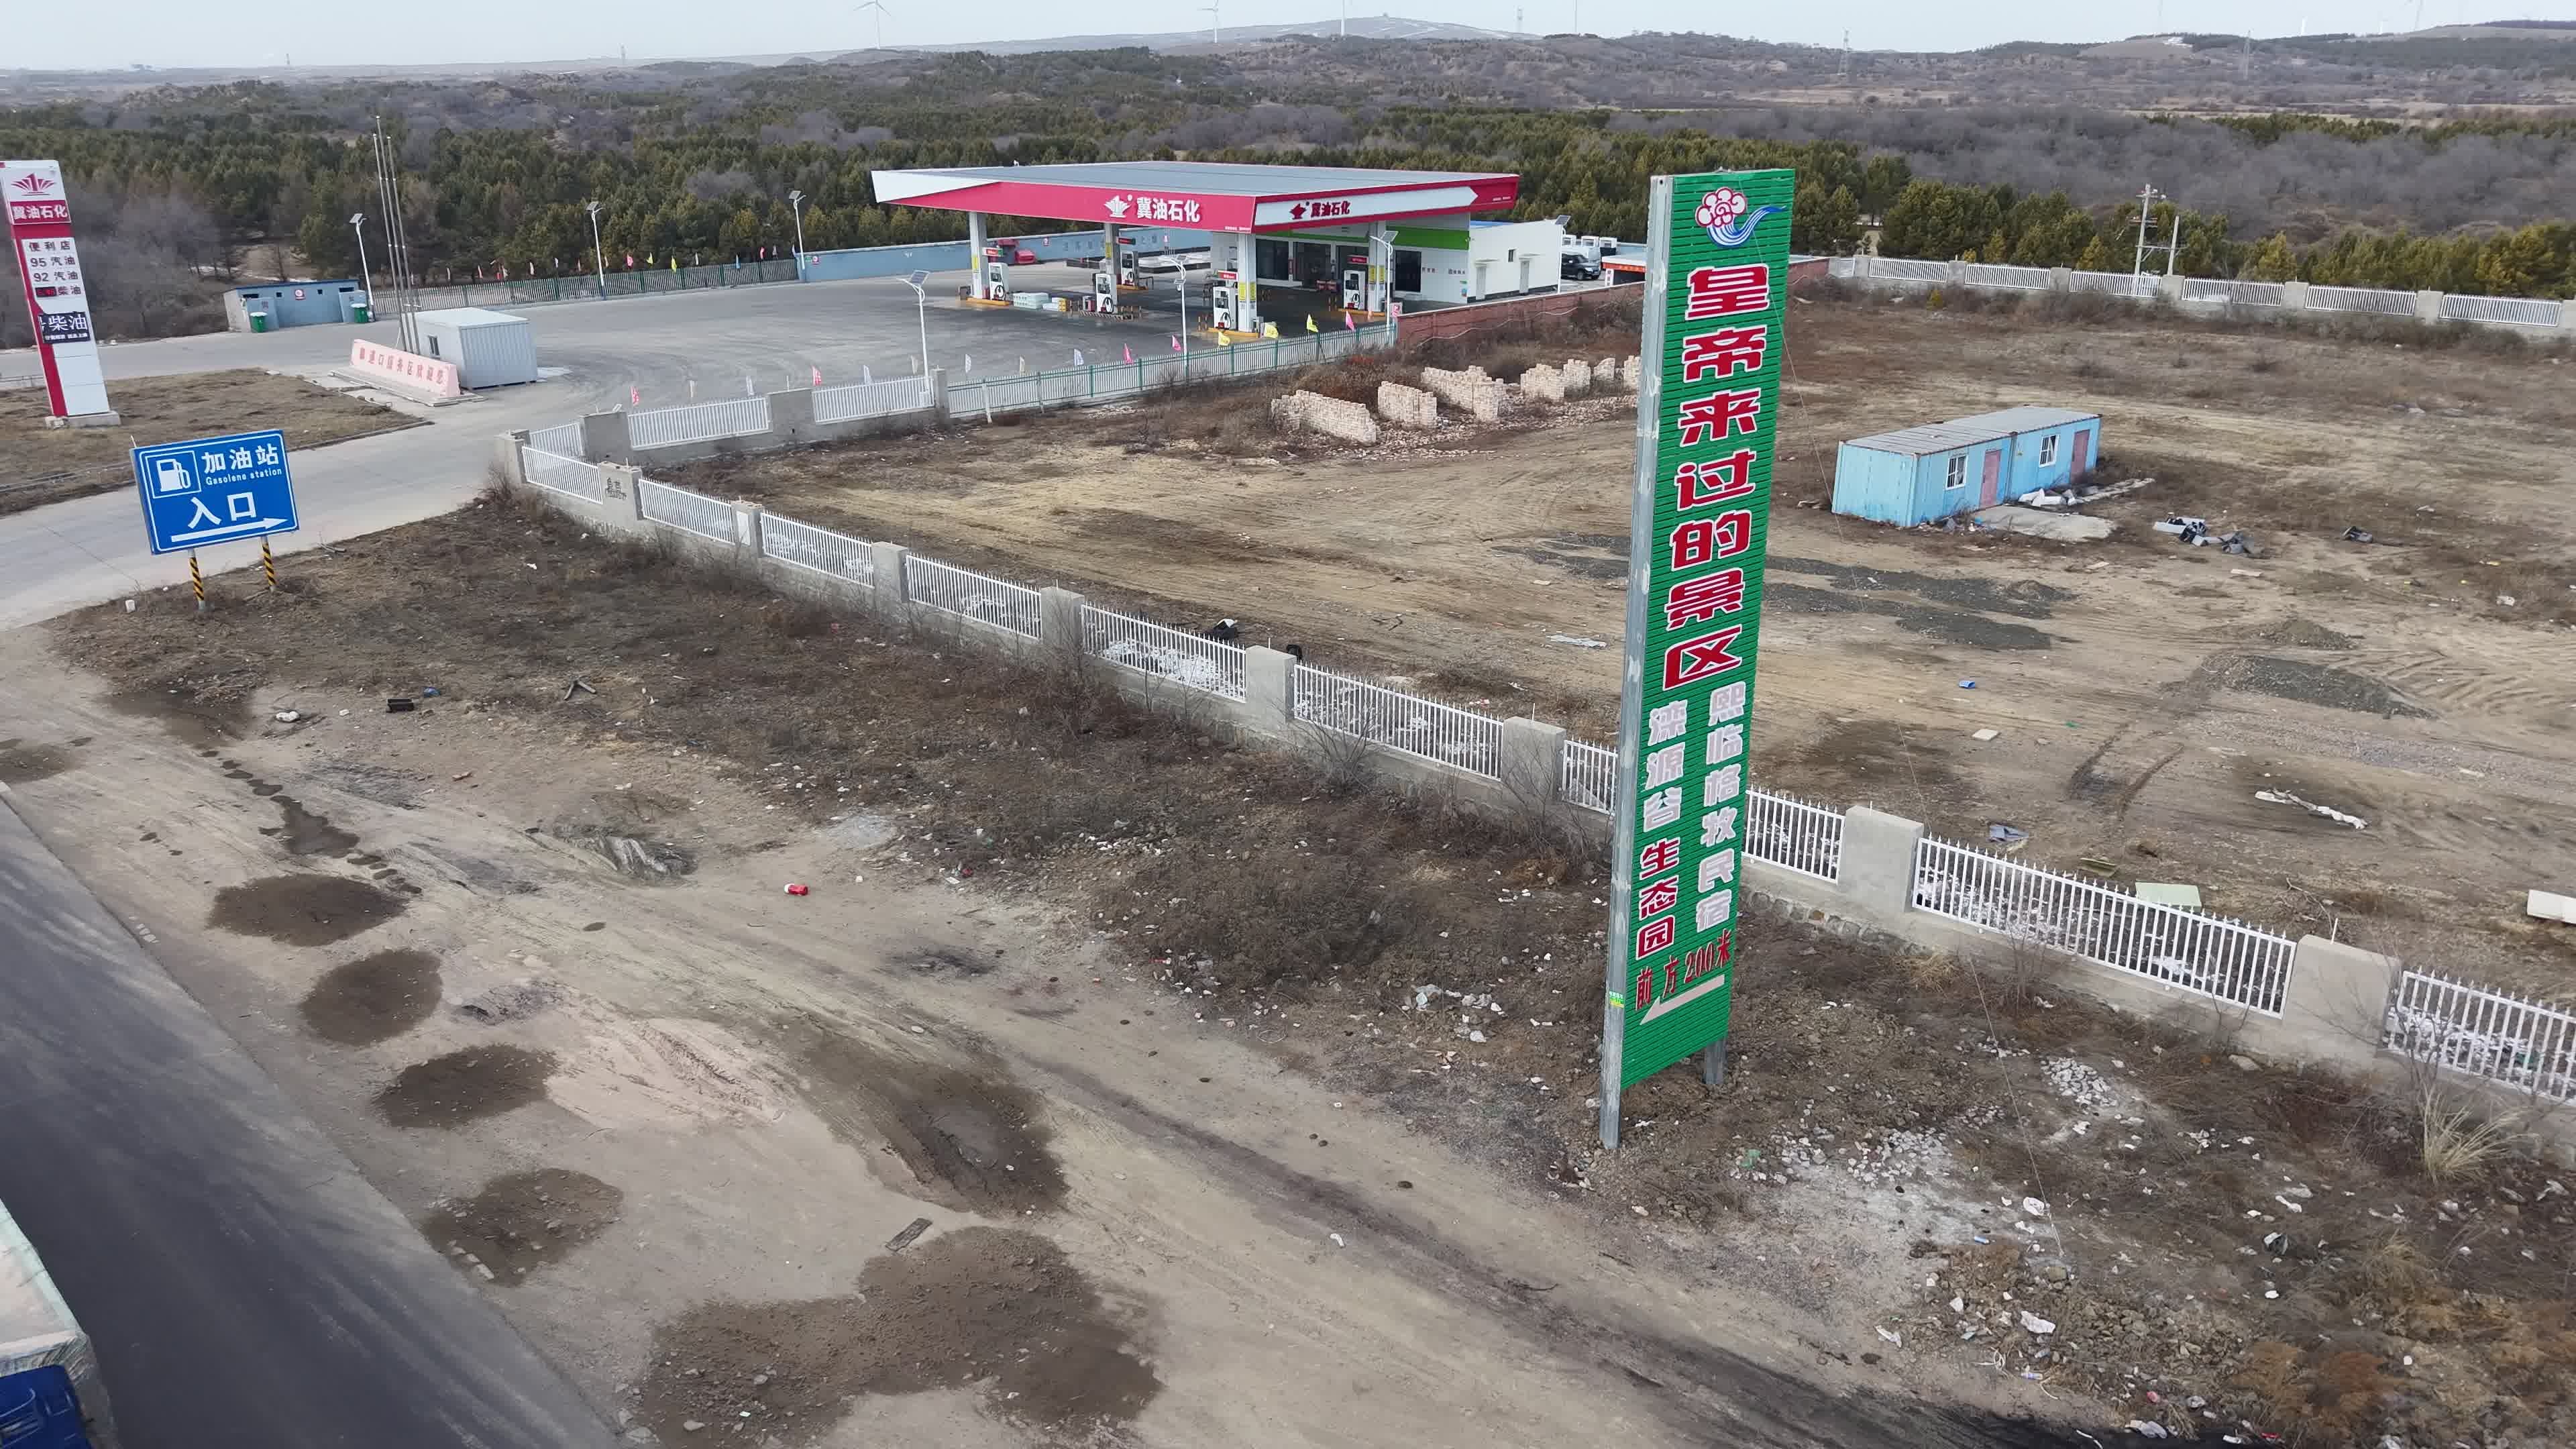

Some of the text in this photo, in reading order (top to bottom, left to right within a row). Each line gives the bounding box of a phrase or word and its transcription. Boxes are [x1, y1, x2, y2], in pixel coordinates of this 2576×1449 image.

[13, 205, 68, 220] 冀油石化
[1136, 197, 1200, 222] 冀油石化
[29, 241, 70, 253] 便利店
[30, 256, 76, 268] 95 汽油
[34, 271, 78, 282] 92 汽油
[58, 286, 82, 296] 柴油
[201, 443, 279, 474] 加油站
[250, 468, 282, 480] station
[1662, 263, 1770, 691] 皇帝来过的景区
[187, 492, 256, 529] 入口
[1635, 928, 1731, 1011] 前方200米
